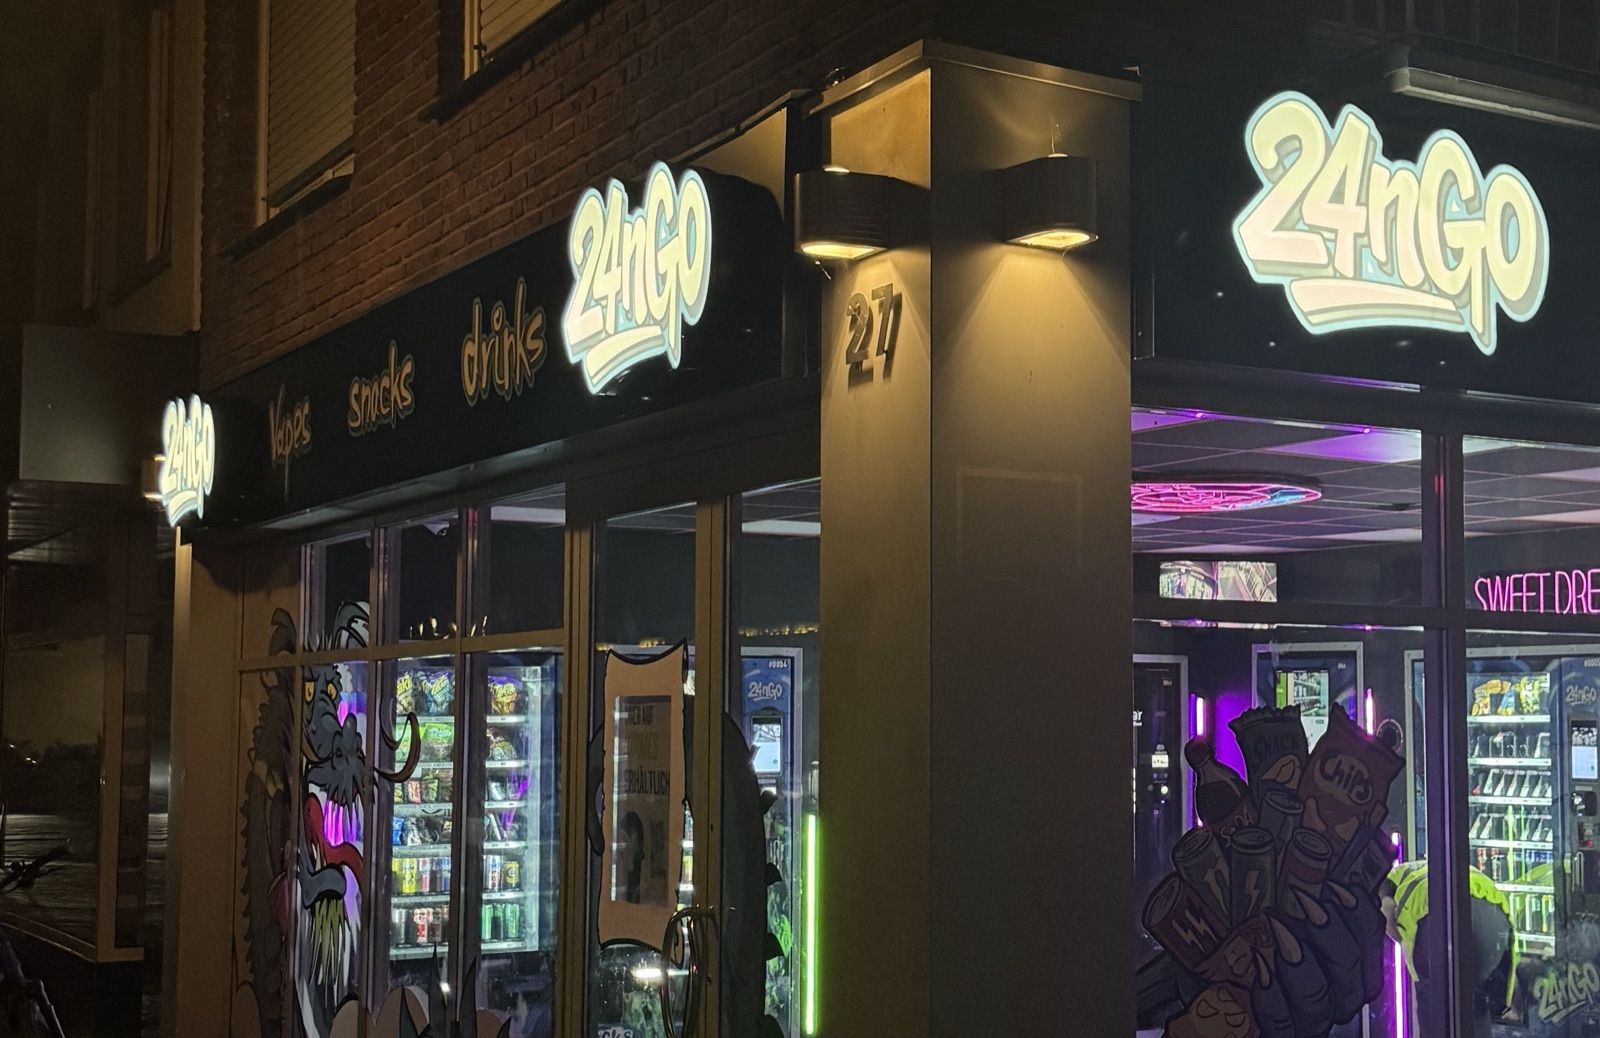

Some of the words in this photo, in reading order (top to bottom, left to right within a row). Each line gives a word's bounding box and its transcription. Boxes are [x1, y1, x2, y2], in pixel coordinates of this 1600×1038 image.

[349, 343, 414, 432] snacks
[462, 279, 546, 402] drinks
[844, 282, 894, 366] 27
